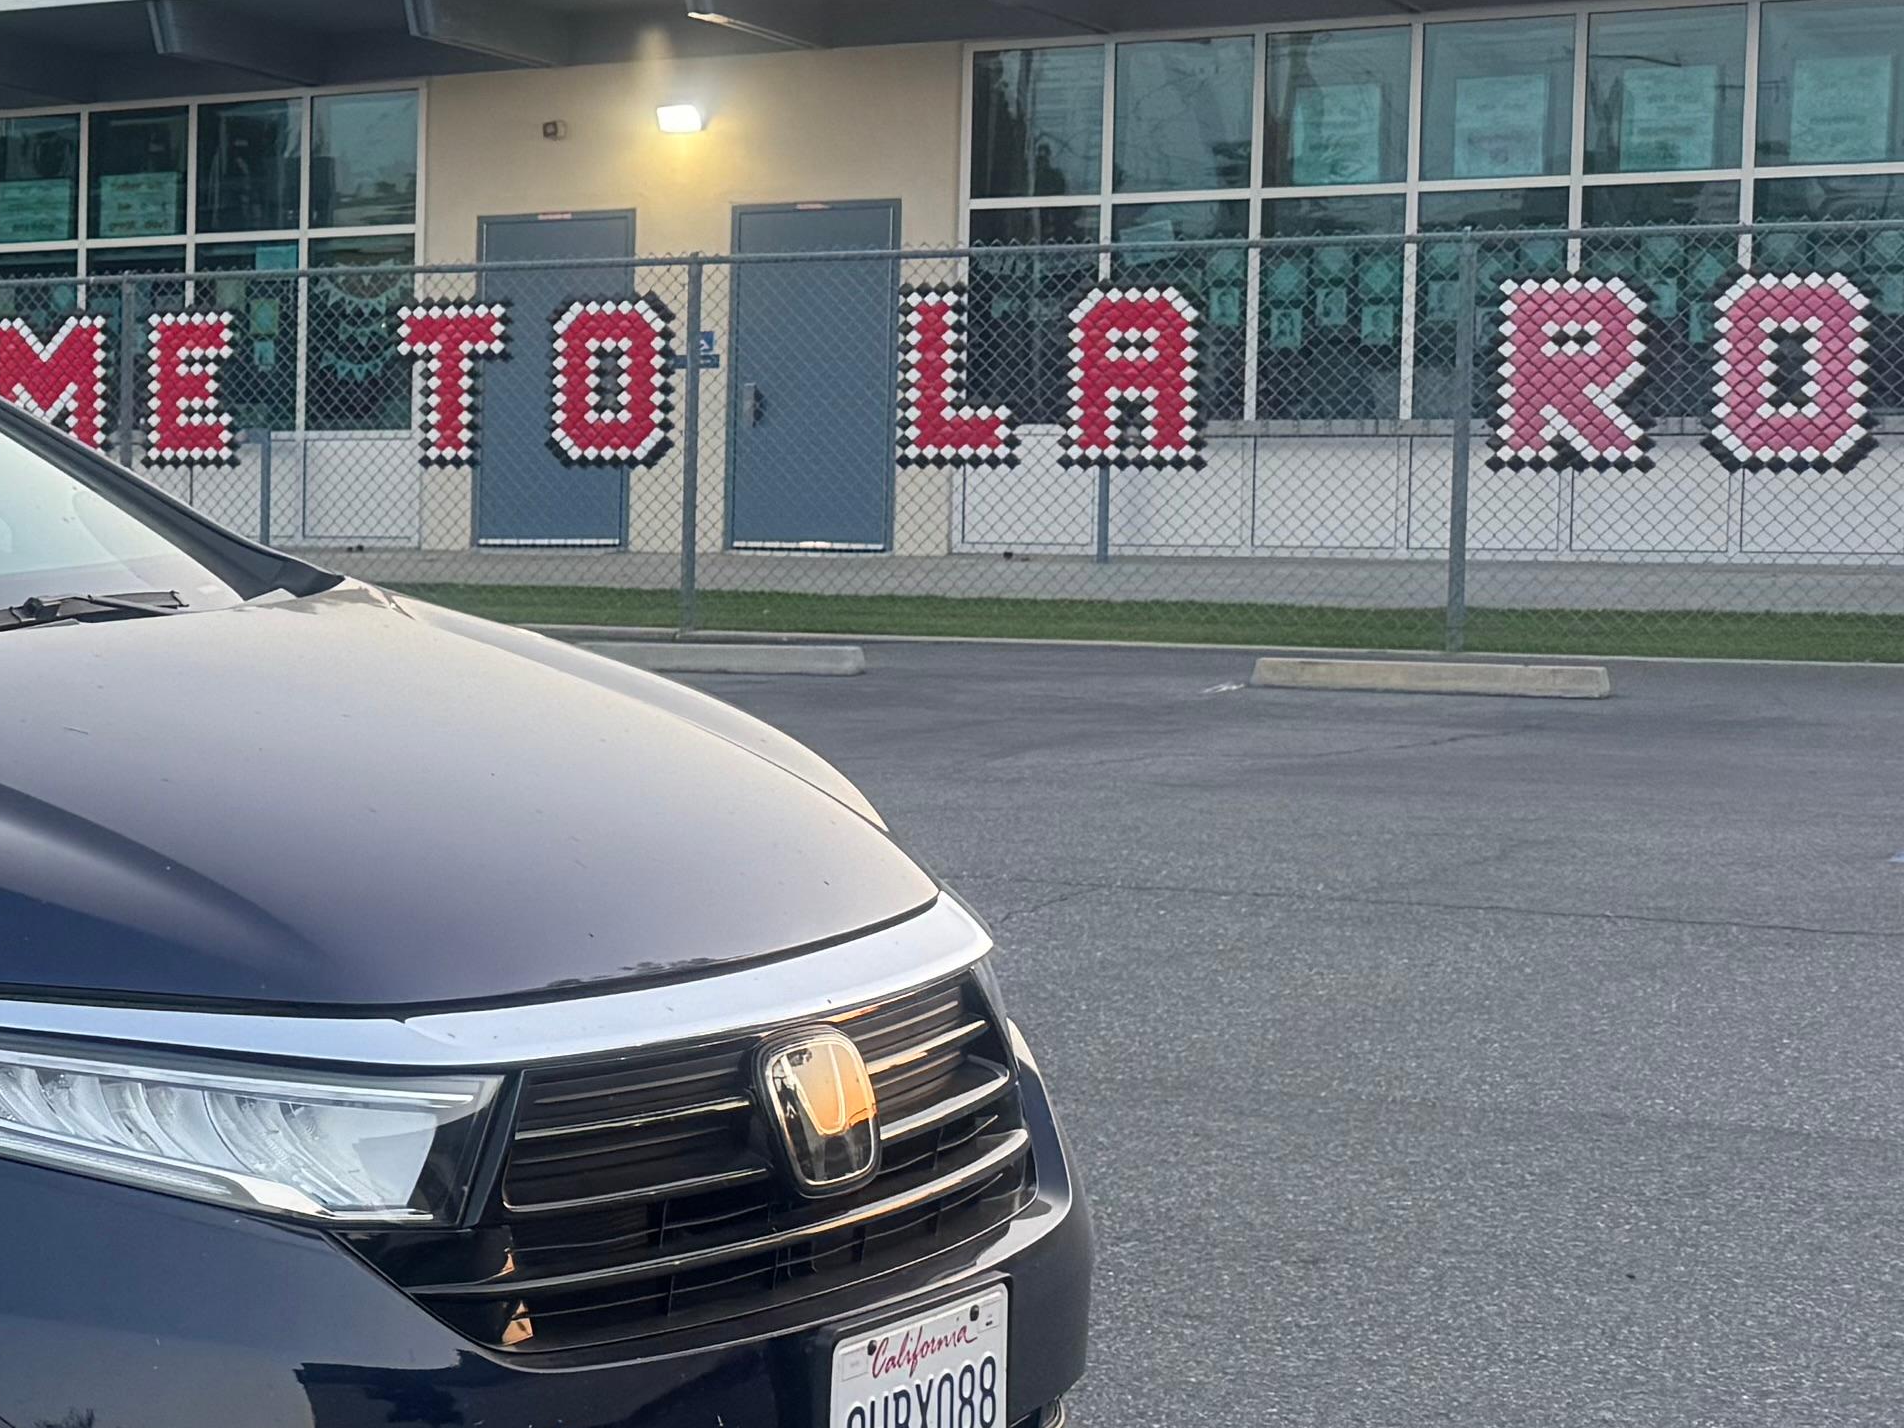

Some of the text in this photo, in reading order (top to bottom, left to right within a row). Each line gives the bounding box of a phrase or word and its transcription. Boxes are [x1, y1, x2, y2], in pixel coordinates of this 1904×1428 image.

[397, 291, 675, 469] TO
[896, 282, 1207, 470] LA
[1484, 271, 1879, 472] RO
[872, 1325, 977, 1379] California
